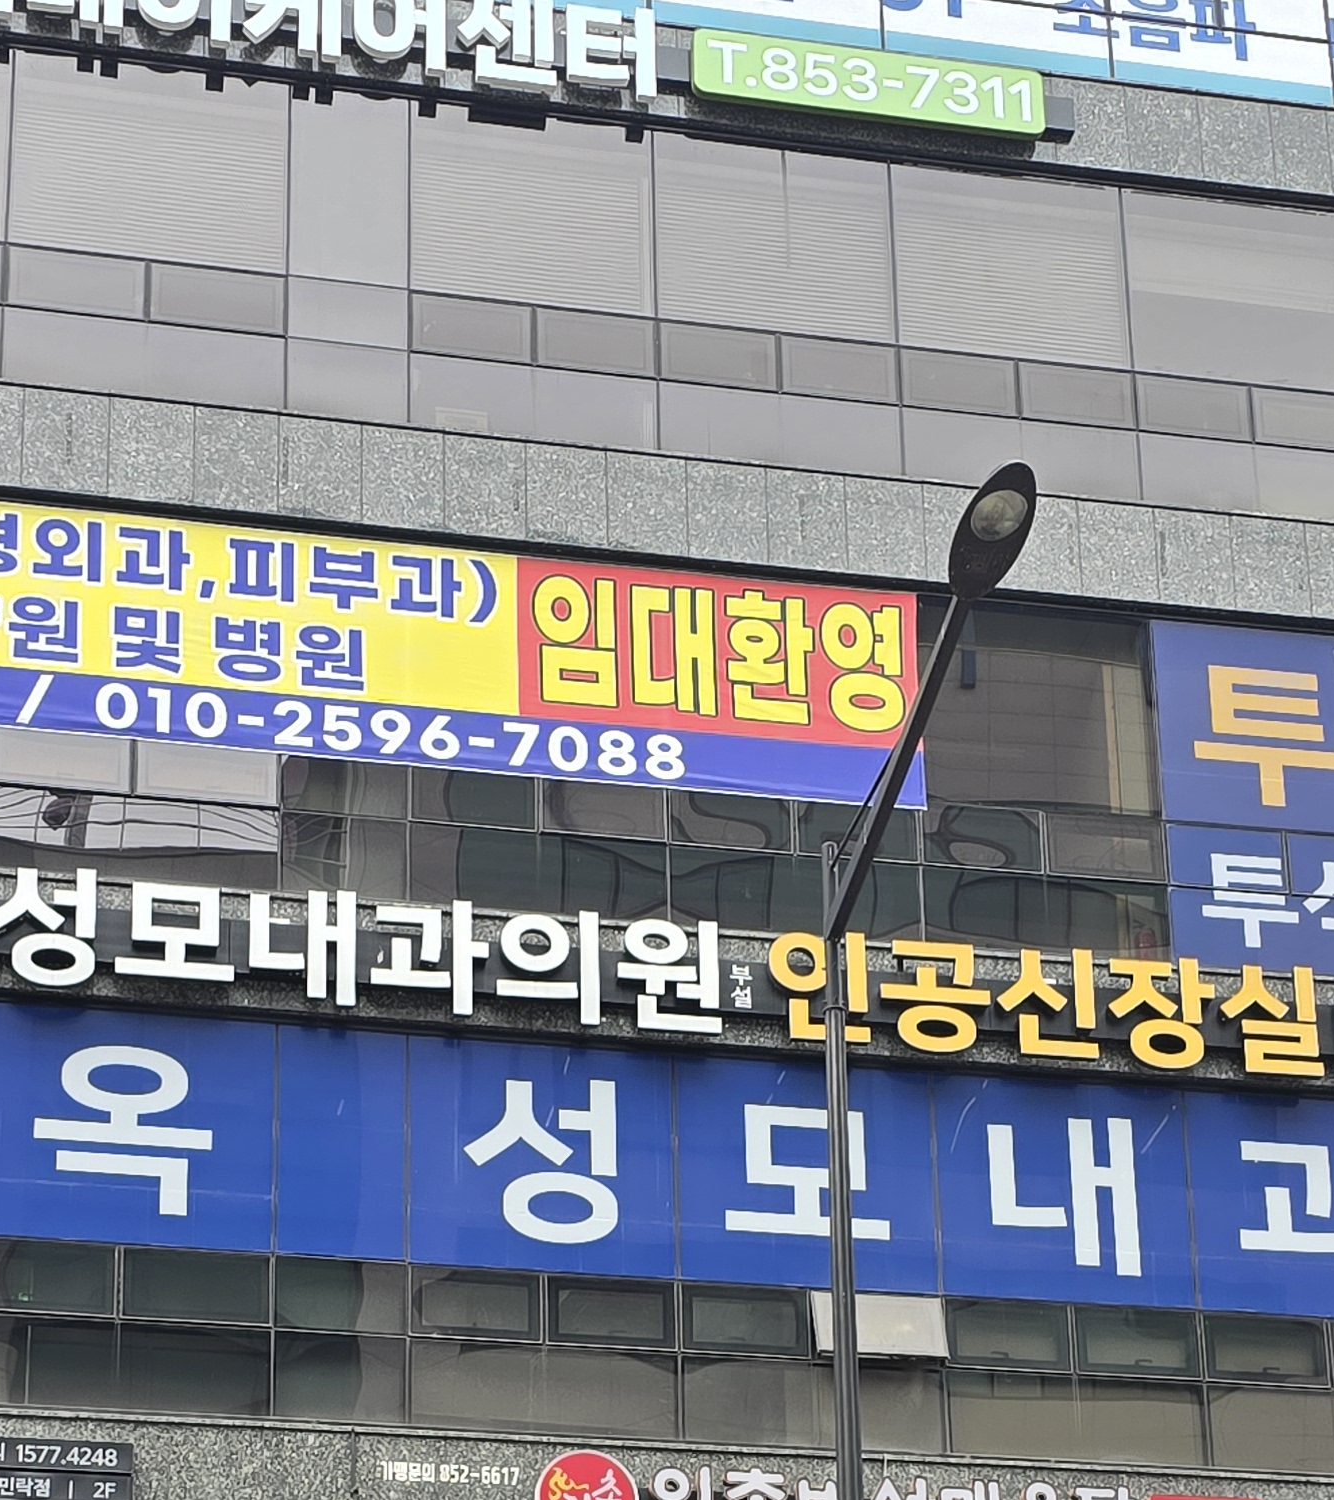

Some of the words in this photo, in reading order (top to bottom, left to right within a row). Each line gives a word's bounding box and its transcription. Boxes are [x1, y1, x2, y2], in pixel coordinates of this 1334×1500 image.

[706, 38, 1034, 122] T.853-7311
[113, 605, 182, 673] 및
[213, 612, 365, 692] 병원
[531, 573, 907, 733] 임대환영
[94, 682, 687, 779] 010-2596-7088
[729, 963, 754, 1010] 부설
[768, 931, 1326, 1078] 인공신장실
[15, 1441, 119, 1469] 1577.4248
[93, 1483, 117, 1500] 2F
[439, 1464, 520, 1487] 852-6617
